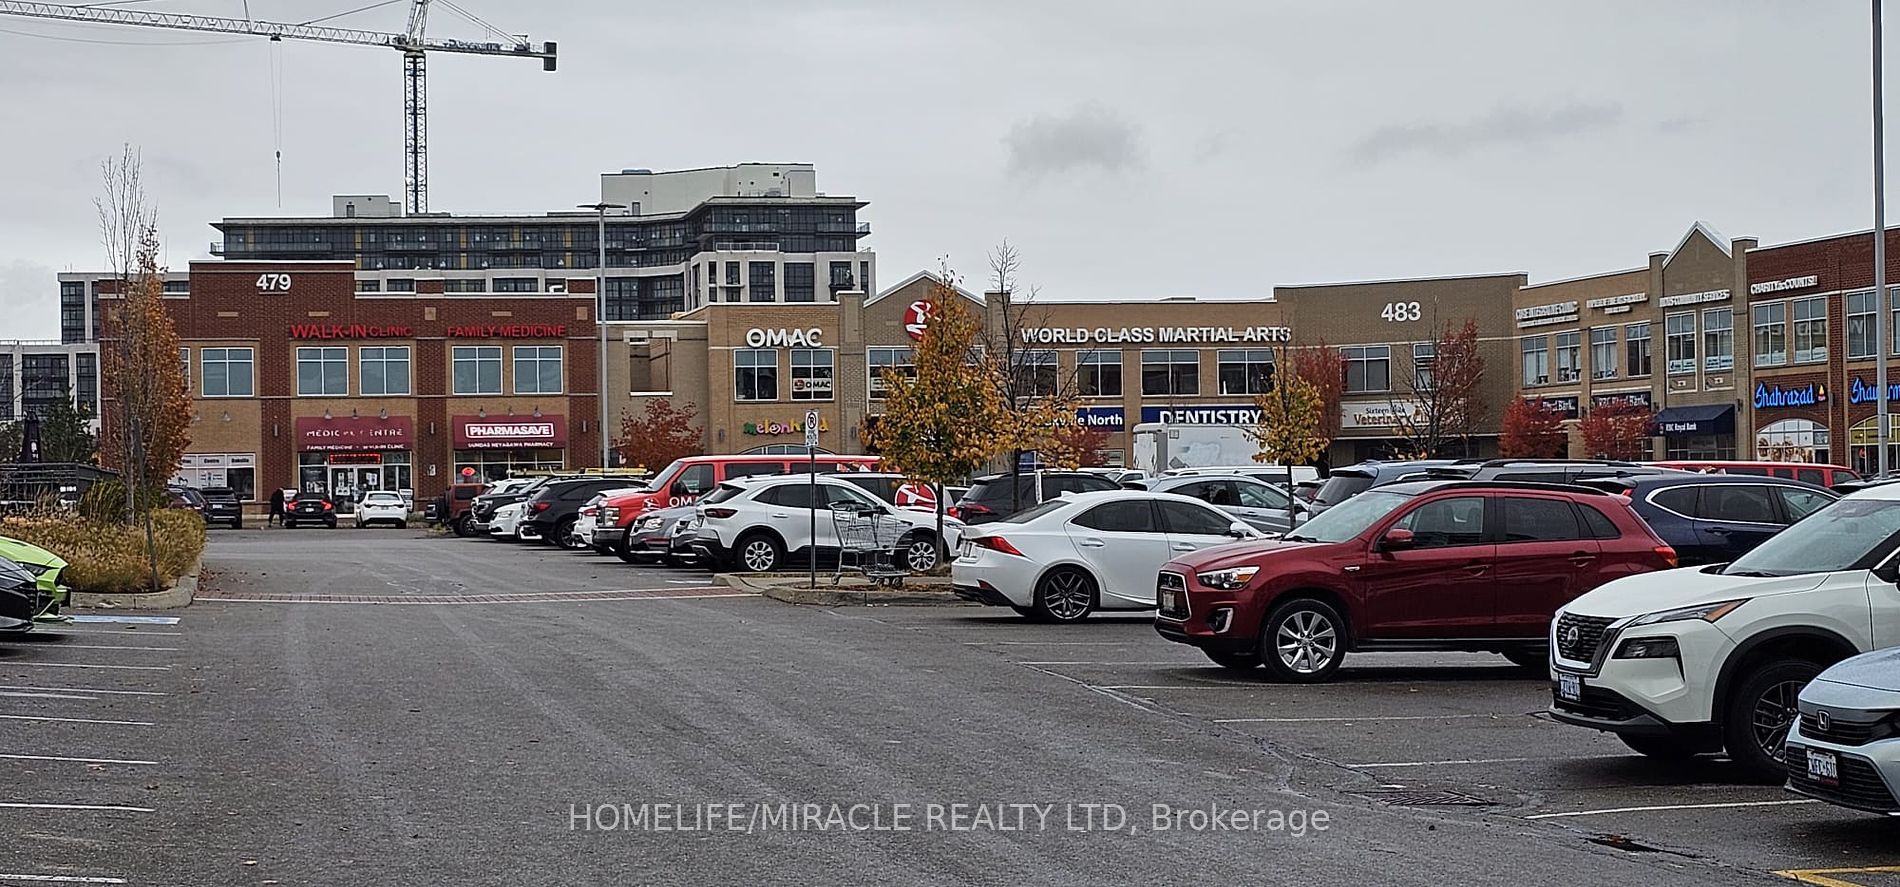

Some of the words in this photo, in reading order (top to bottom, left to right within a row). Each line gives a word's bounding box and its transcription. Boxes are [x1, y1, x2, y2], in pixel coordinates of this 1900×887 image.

[256, 274, 292, 290] 479
[1381, 302, 1421, 321] 483
[291, 325, 367, 339] WALK-IN
[369, 327, 413, 337] CLINIC
[448, 326, 495, 337] FAMILY
[500, 325, 566, 337] MEDICINE
[746, 328, 823, 348] OMAC
[1021, 328, 1090, 343] WORLD
[1094, 328, 1155, 343] CLASS
[1158, 327, 1239, 342] MARTIAL
[1243, 326, 1292, 342] ARTS
[805, 381, 831, 389] OMAC
[1754, 383, 1816, 408] Shahrazad
[1087, 413, 1123, 426] North
[1160, 409, 1262, 424] DENTISTRY
[469, 426, 550, 436] PHARMASAVE
